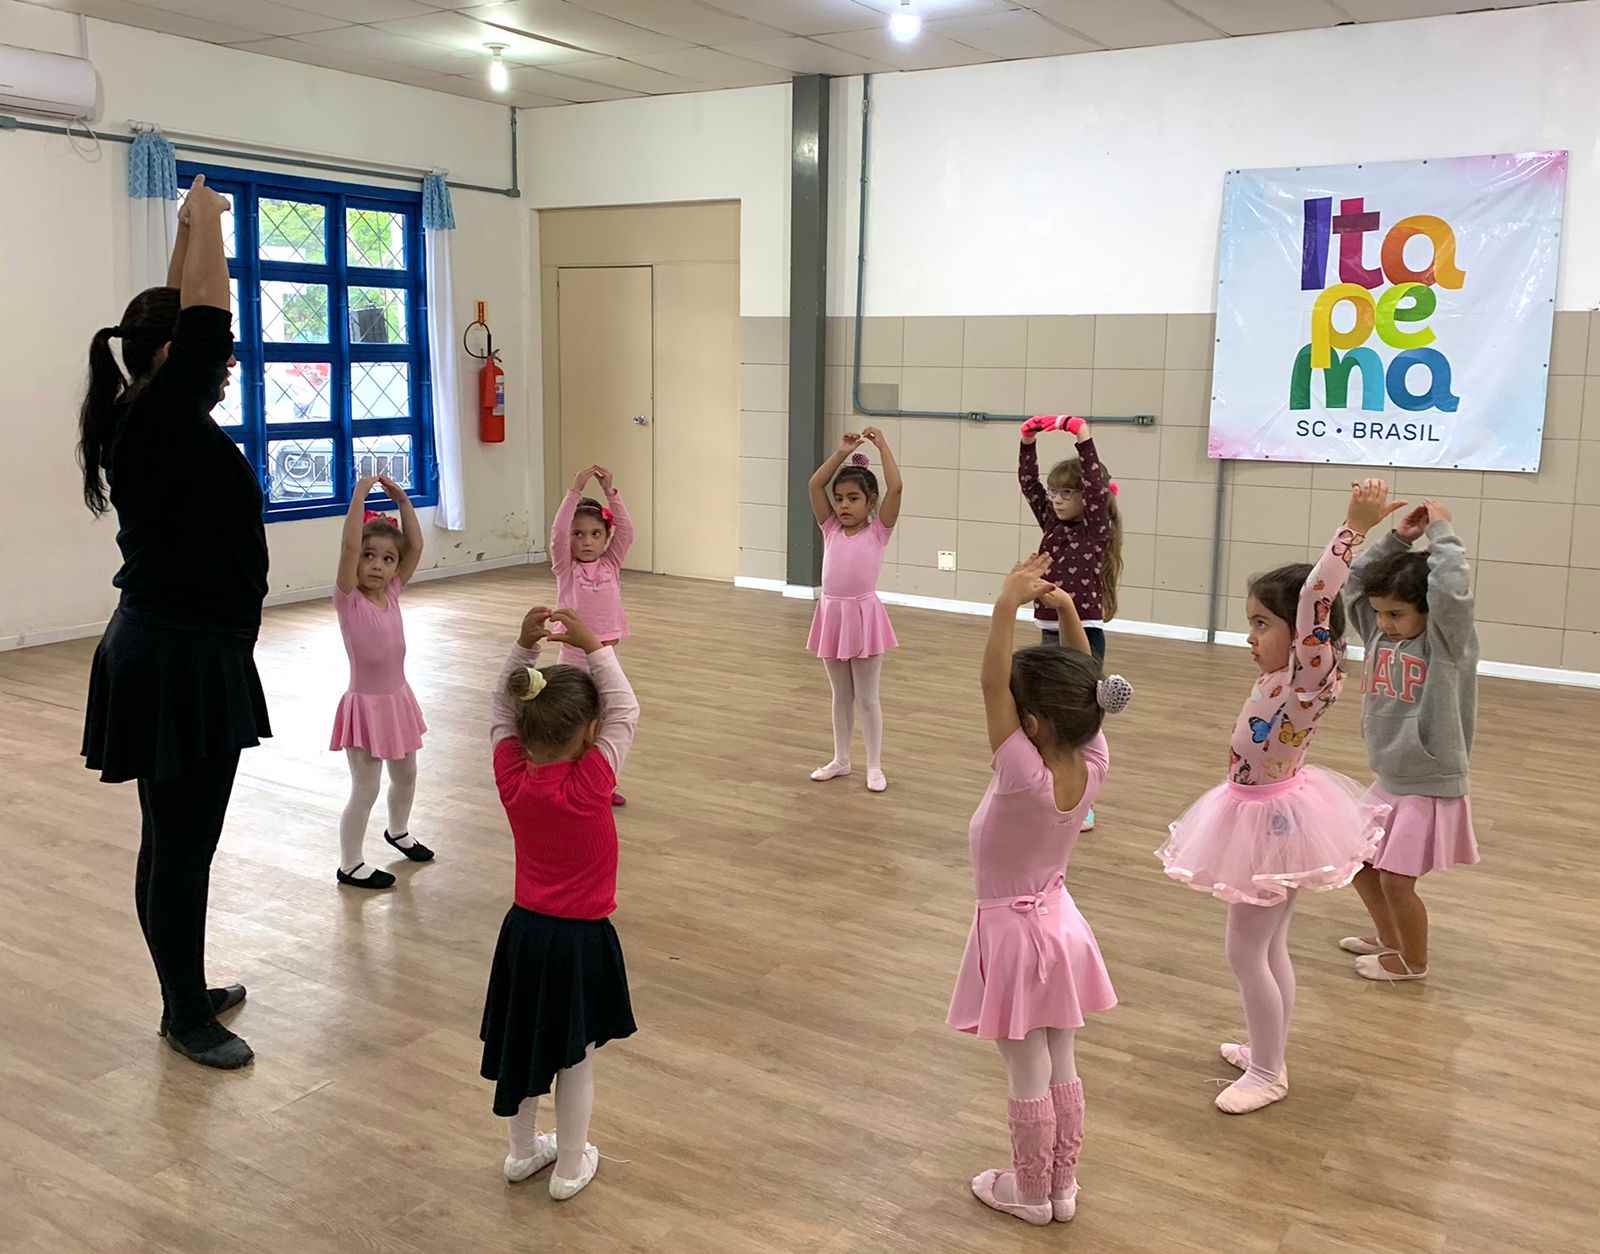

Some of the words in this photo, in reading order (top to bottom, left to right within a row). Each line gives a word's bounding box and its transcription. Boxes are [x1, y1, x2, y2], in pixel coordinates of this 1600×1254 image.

[1301, 196, 1466, 290] Ita
[1311, 282, 1437, 368] pe
[1289, 343, 1460, 412] ma
[1296, 420, 1327, 437] SC
[1353, 422, 1440, 441] BRASIL
